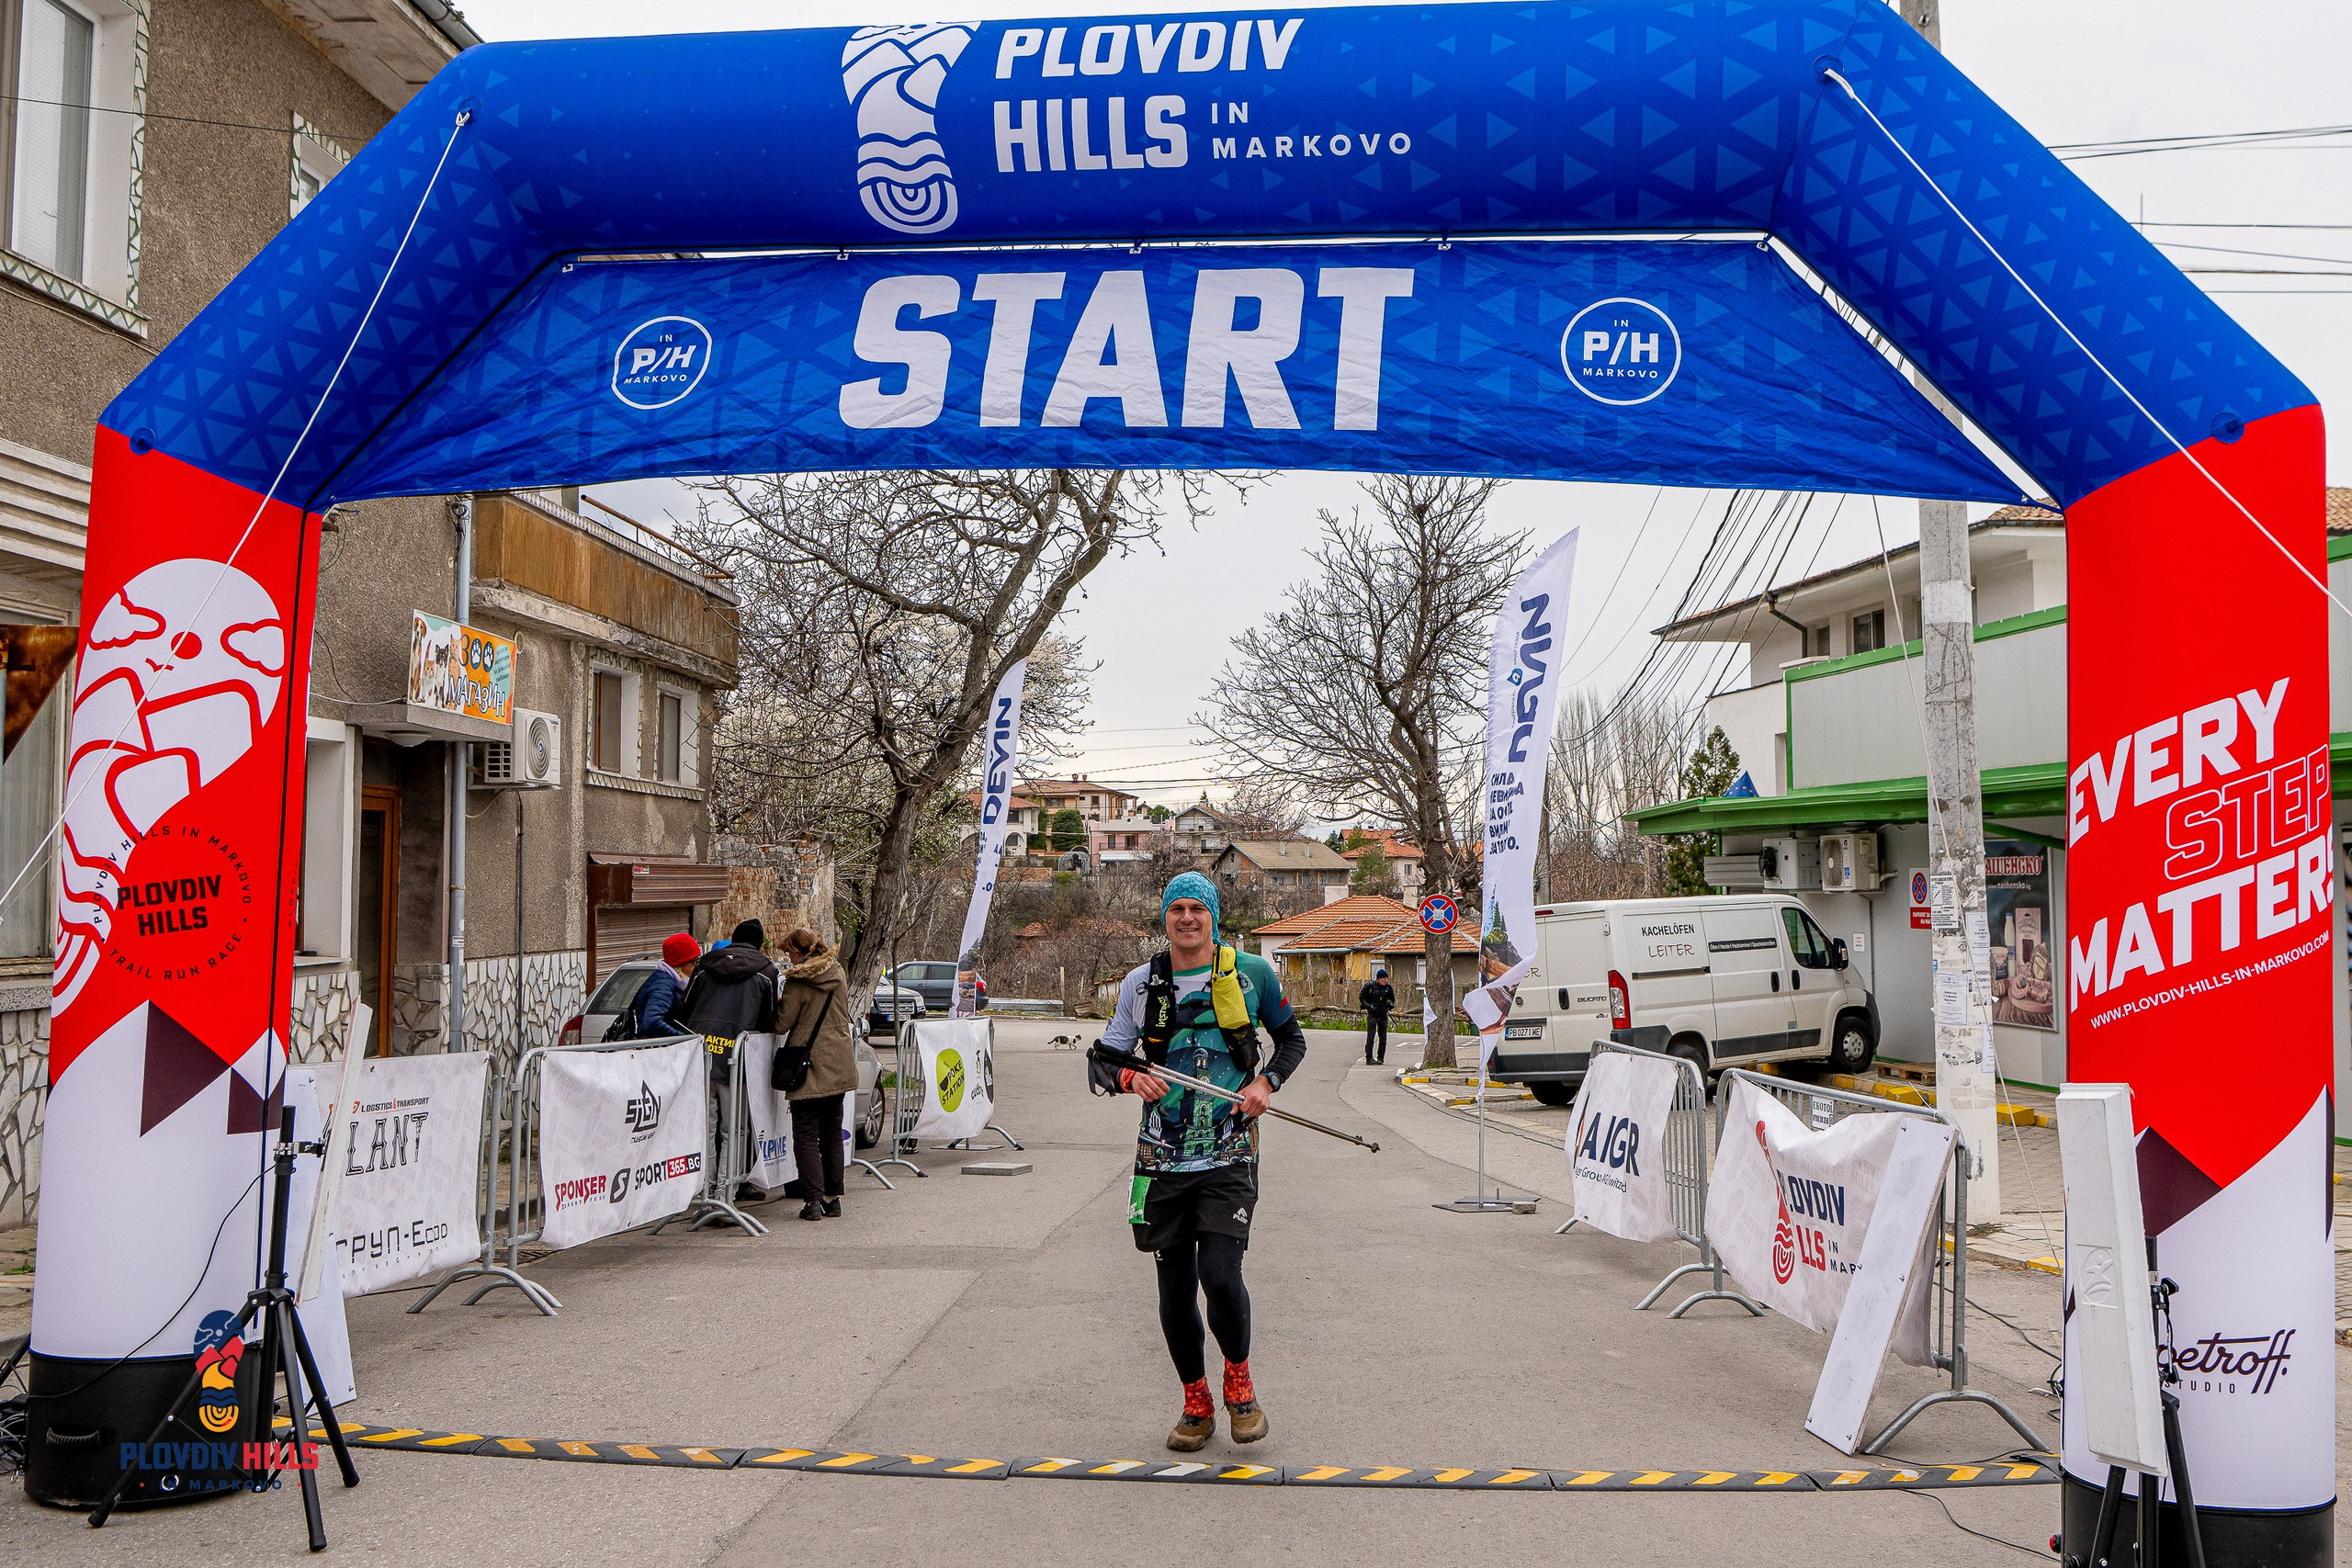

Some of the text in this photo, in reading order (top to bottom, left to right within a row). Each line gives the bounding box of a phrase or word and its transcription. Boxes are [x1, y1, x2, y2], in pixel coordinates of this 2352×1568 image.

[995, 18, 1305, 79] PLOVDIV
[1211, 102, 1249, 124] IN
[993, 95, 1189, 173] HILLS
[1212, 132, 1412, 159] MARKOVO
[659, 334, 673, 343] IN
[1614, 319, 1629, 327] IN
[630, 344, 696, 375] P/H
[838, 267, 1415, 432] START
[1583, 331, 1659, 366] P/H
[624, 374, 687, 384] MARKOVO
[1583, 367, 1658, 378] MARKOVO
[447, 675, 506, 717] МАГАЗИН
[983, 697, 1012, 825] DEVIN
[2070, 677, 2290, 849] EVERY
[2165, 744, 2329, 881] STEP
[93, 825, 252, 924] PLOVDIV HILLS IN MARKOVO
[1985, 855, 2042, 875] АШЕНСКО
[117, 874, 221, 910] PLOVDIV
[1987, 881, 2031, 890] www.nashensko.bg
[138, 906, 209, 937] HILLS
[1641, 923, 1695, 937] KACHELÖFEN
[108, 933, 242, 980] TRAIL RUN RACE
[1648, 943, 1695, 958] LEITER
[2090, 929, 2330, 1030] WWW.PLOVDIV-HILLS-IN-MARKOVO.COM
[707, 1043, 724, 1055] 013
[1517, 1028, 1532, 1037] 0271
[397, 1097, 429, 1108] TRANSPORT
[942, 1072, 965, 1105] STATION
[345, 1111, 429, 1177] LANT
[554, 1175, 606, 1212] SPONSER
[1776, 1168, 1845, 1226] OVDIV
[1796, 1224, 1826, 1271] LLS
[1828, 1240, 1839, 1254] IN
